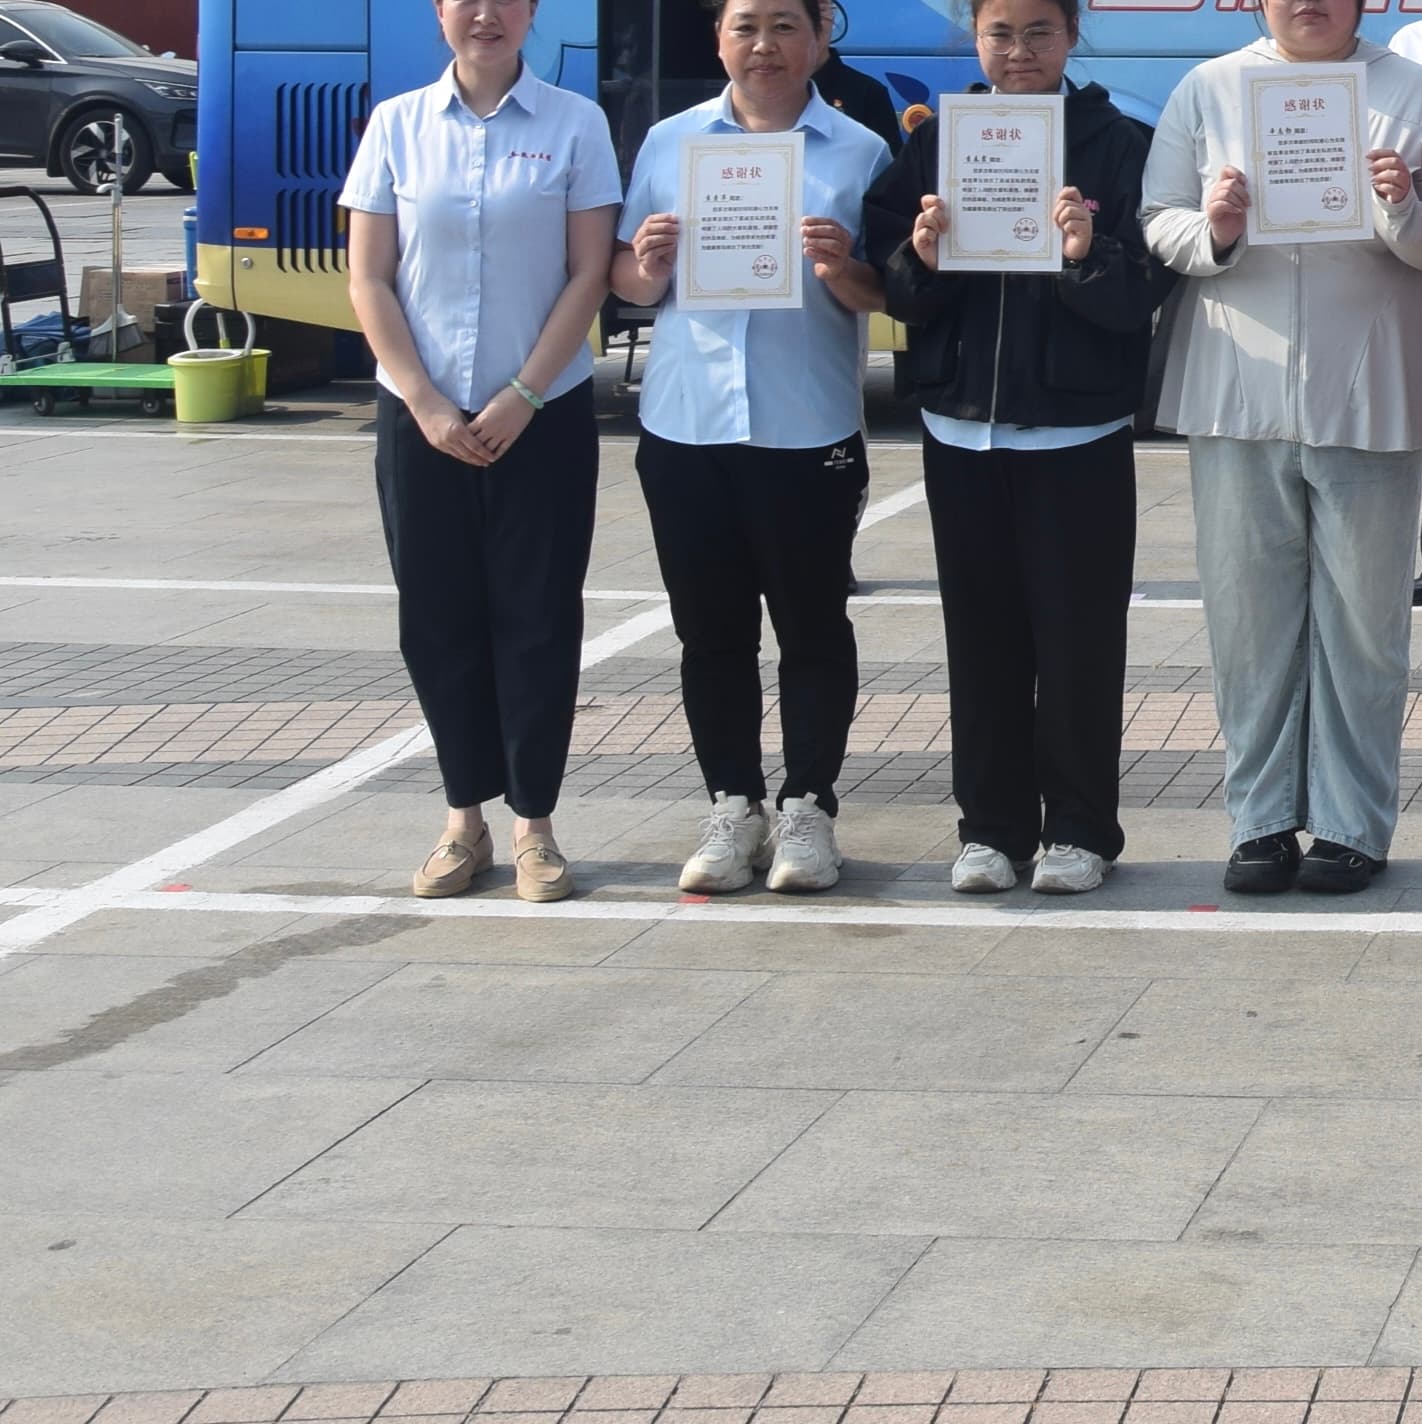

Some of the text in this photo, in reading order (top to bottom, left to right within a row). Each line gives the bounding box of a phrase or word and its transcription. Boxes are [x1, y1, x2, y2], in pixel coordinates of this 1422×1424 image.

[1284, 98, 1326, 112] 感谢状
[981, 127, 1023, 141] 感谢状
[721, 166, 763, 180] 感谢状
